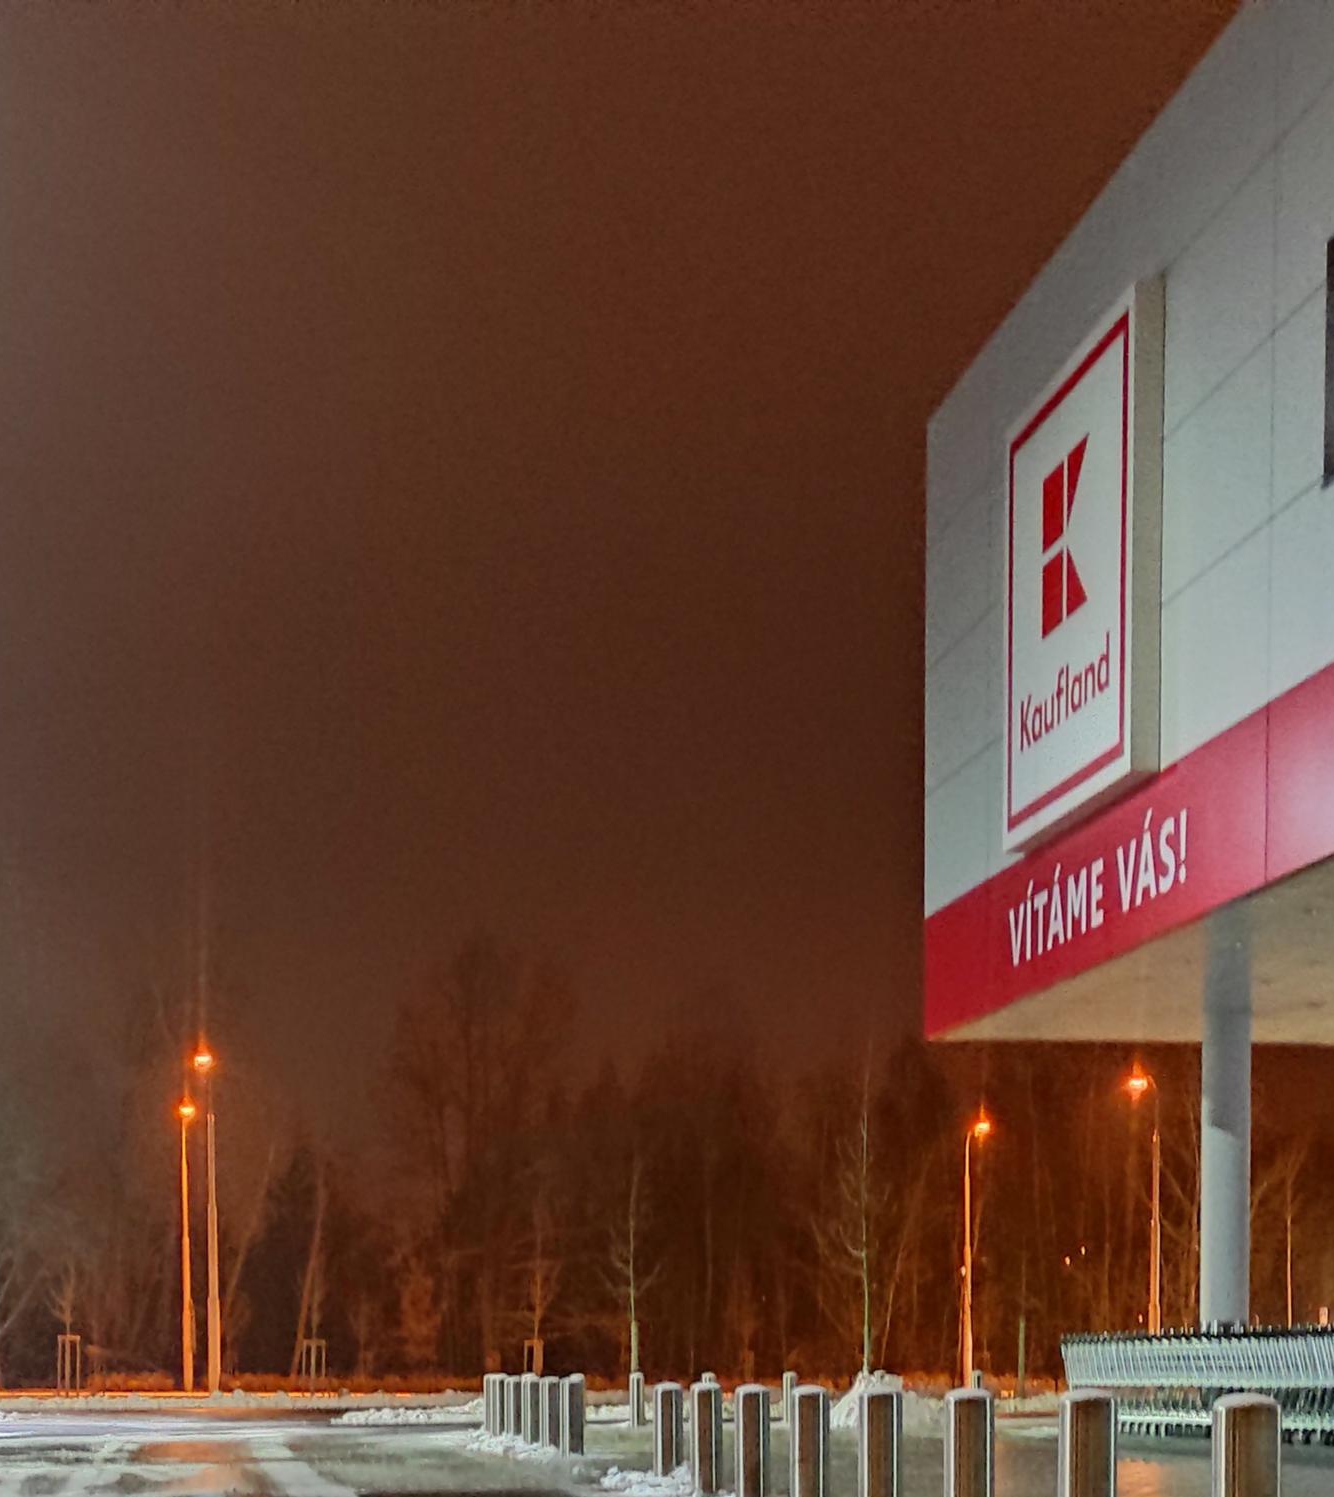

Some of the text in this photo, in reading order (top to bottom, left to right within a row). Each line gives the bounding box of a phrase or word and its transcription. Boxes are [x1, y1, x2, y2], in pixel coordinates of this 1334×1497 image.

[1042, 432, 1090, 639] K
[1019, 630, 1110, 753] Kaufland
[1008, 807, 1188, 968] VÍTÁME VÁS!
